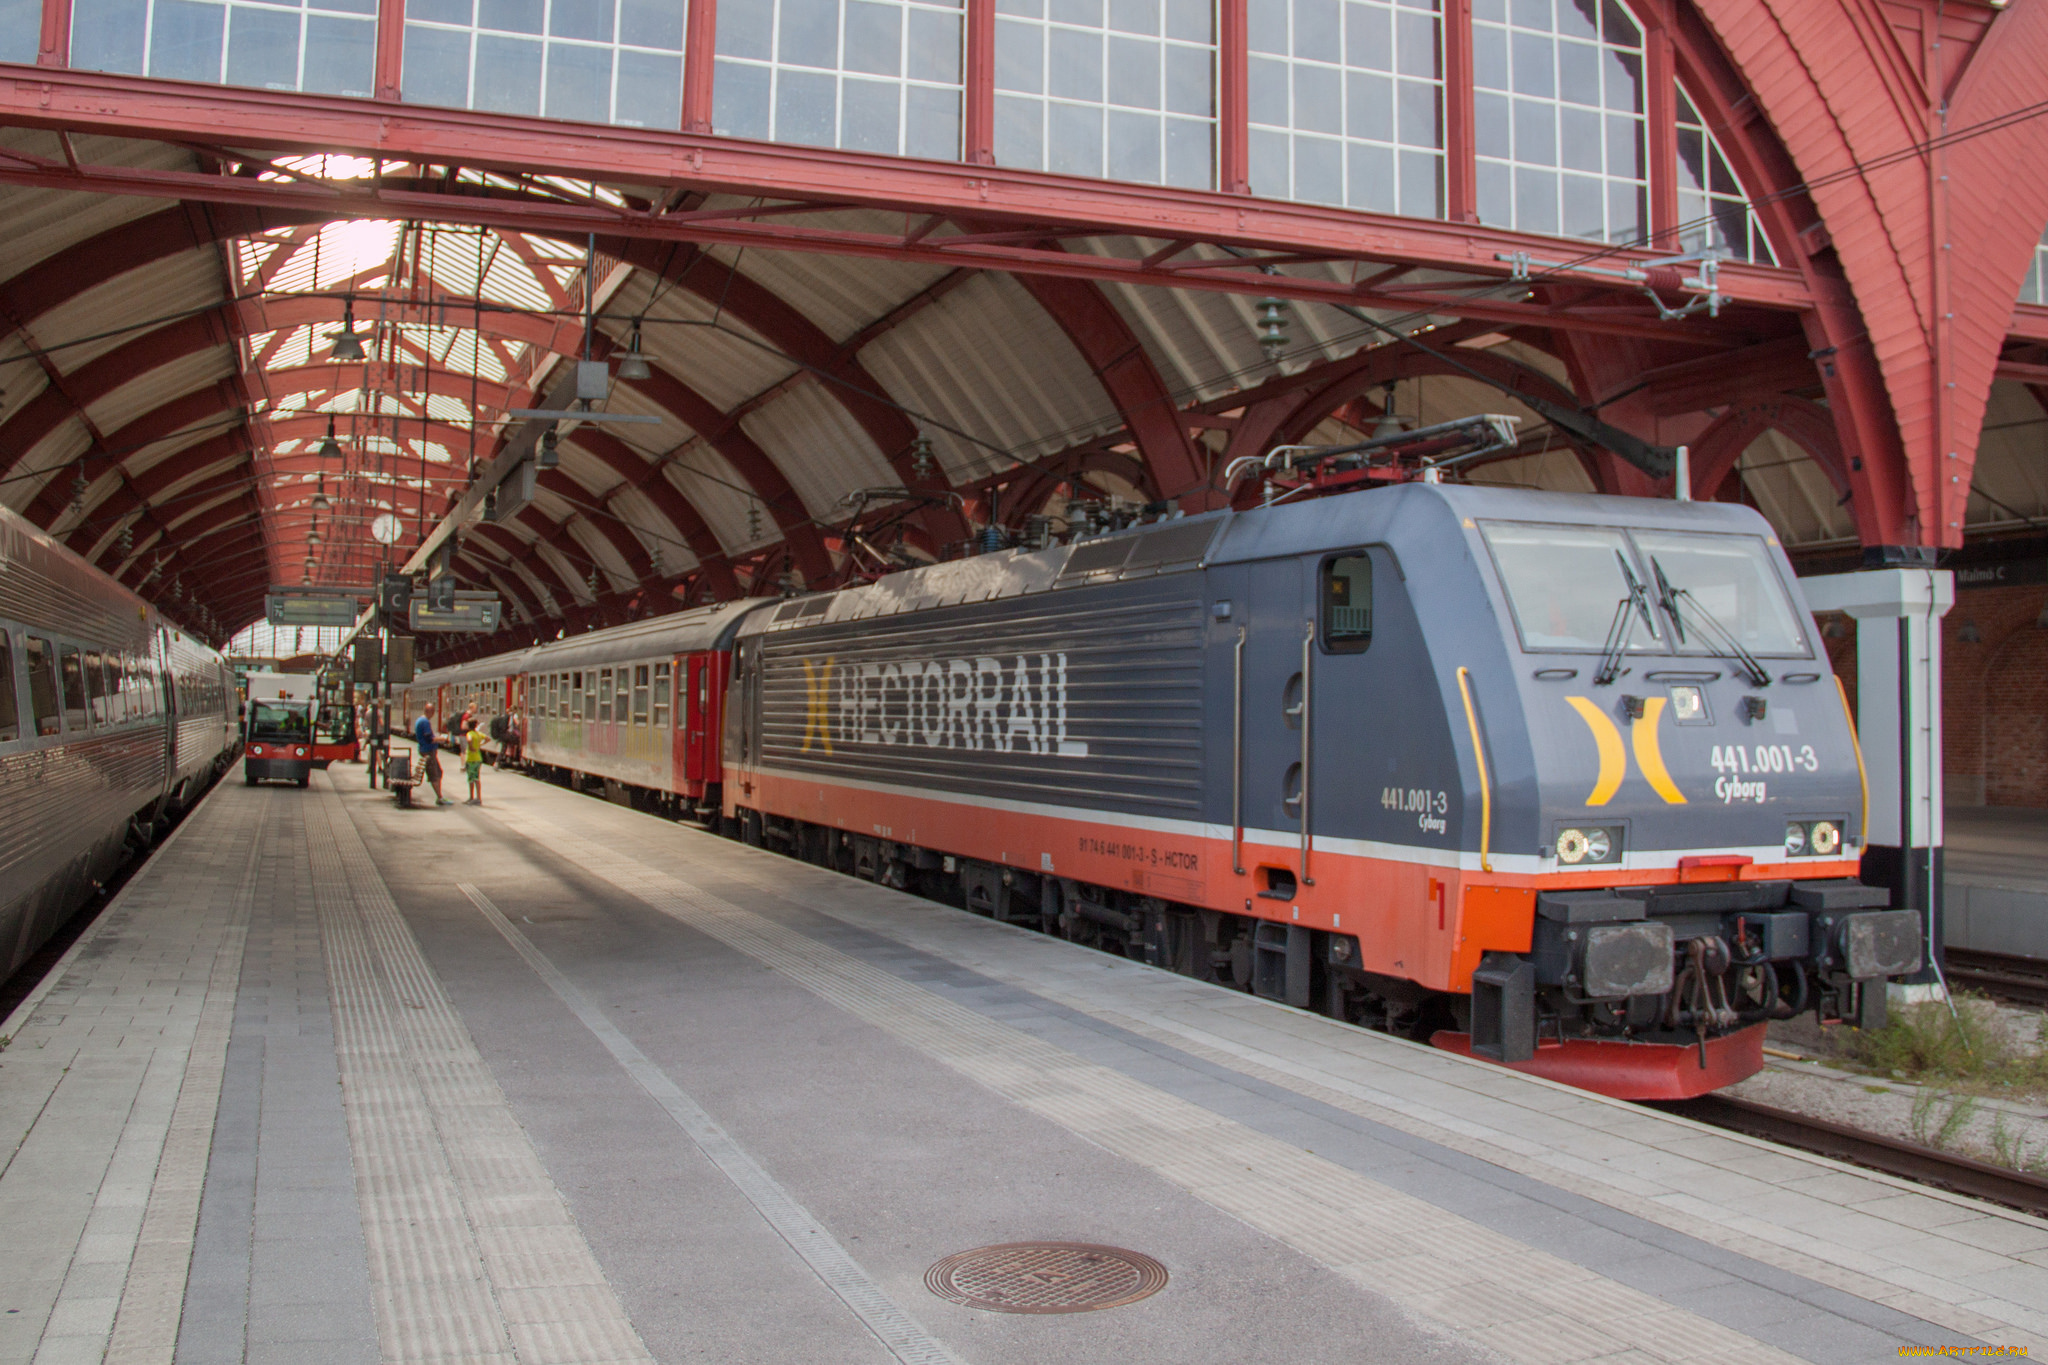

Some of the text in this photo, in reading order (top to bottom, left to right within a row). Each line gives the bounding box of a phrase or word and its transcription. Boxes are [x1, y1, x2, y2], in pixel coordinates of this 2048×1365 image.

[1996, 566, 2006, 579] C
[437, 595, 446, 608] C
[839, 652, 1088, 757] HECTORRAIL
[1711, 745, 1819, 773] 441.001-3
[1381, 787, 1448, 814] 441.001-3
[1715, 774, 1766, 804] Cyborg
[1418, 813, 1447, 835] Cyborg
[1165, 850, 1198, 871] HCTOR
